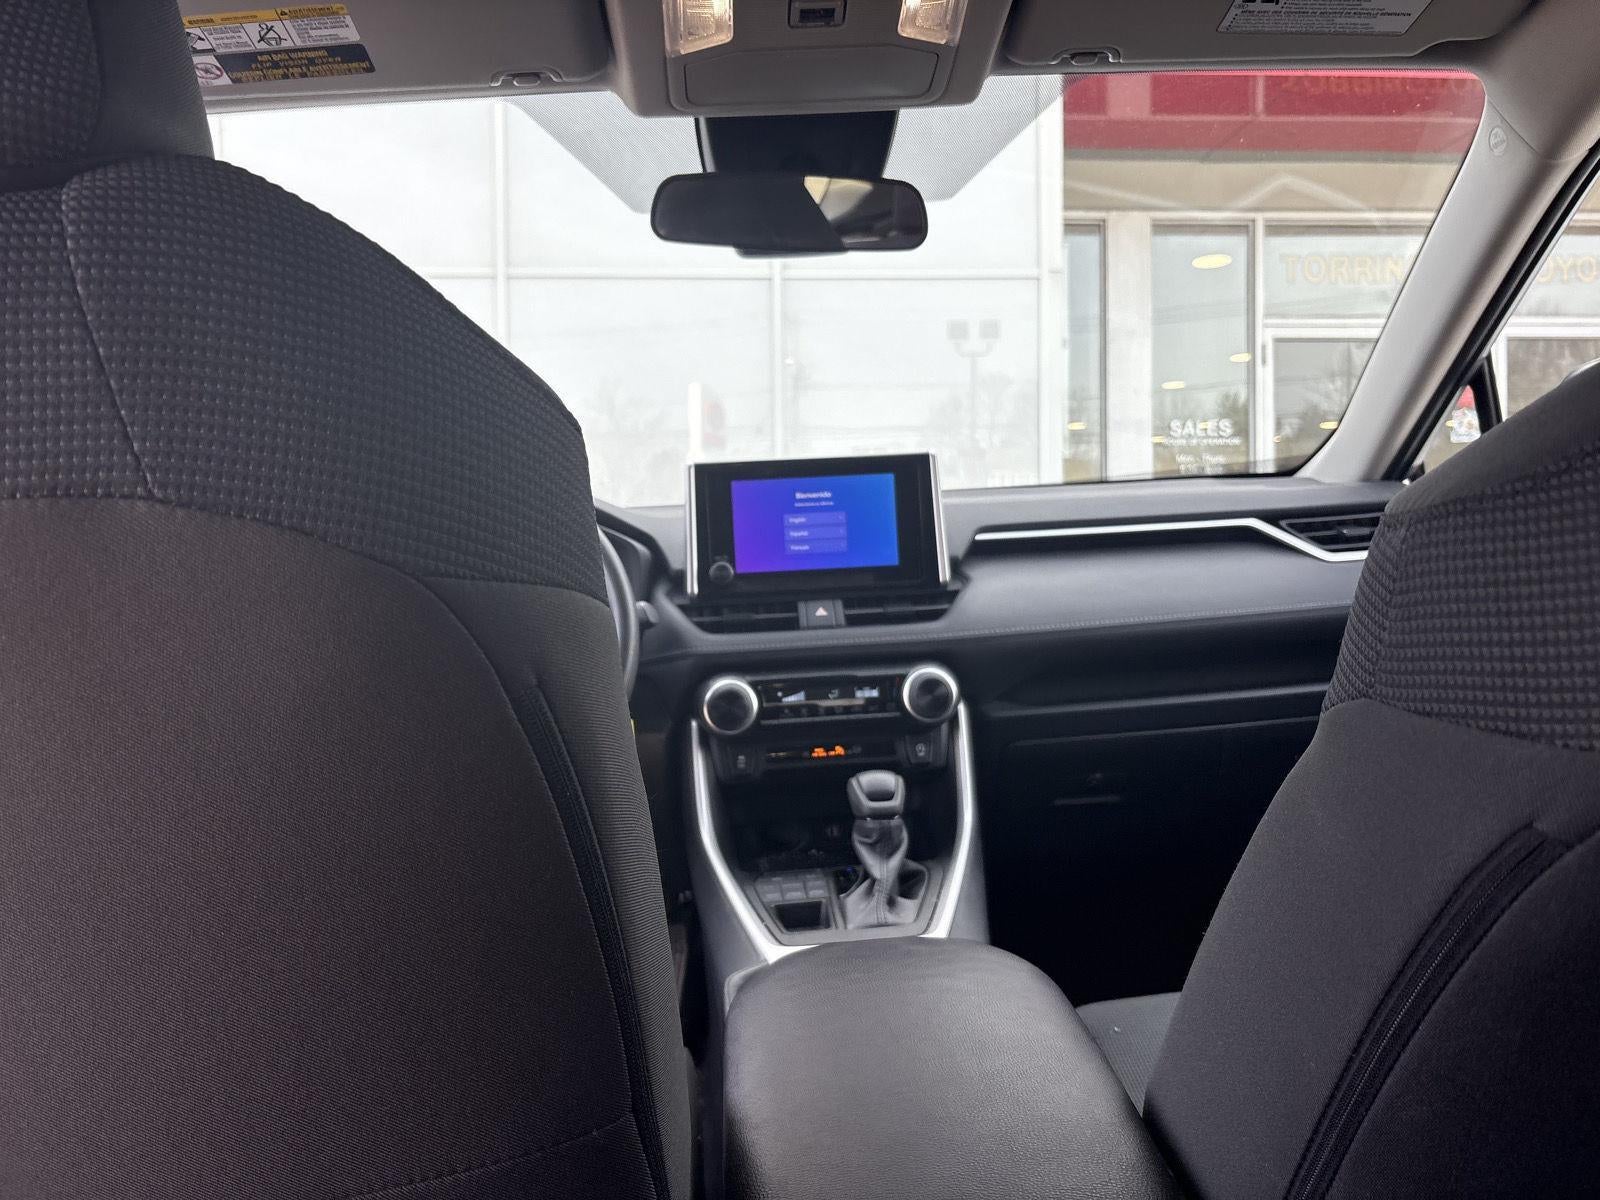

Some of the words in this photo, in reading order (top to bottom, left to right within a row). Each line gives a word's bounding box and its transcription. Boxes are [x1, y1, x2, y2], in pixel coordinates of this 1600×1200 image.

[1279, 253, 1405, 286] TORRIN
[1540, 254, 1600, 285] OYO
[1169, 418, 1234, 437] SALES
